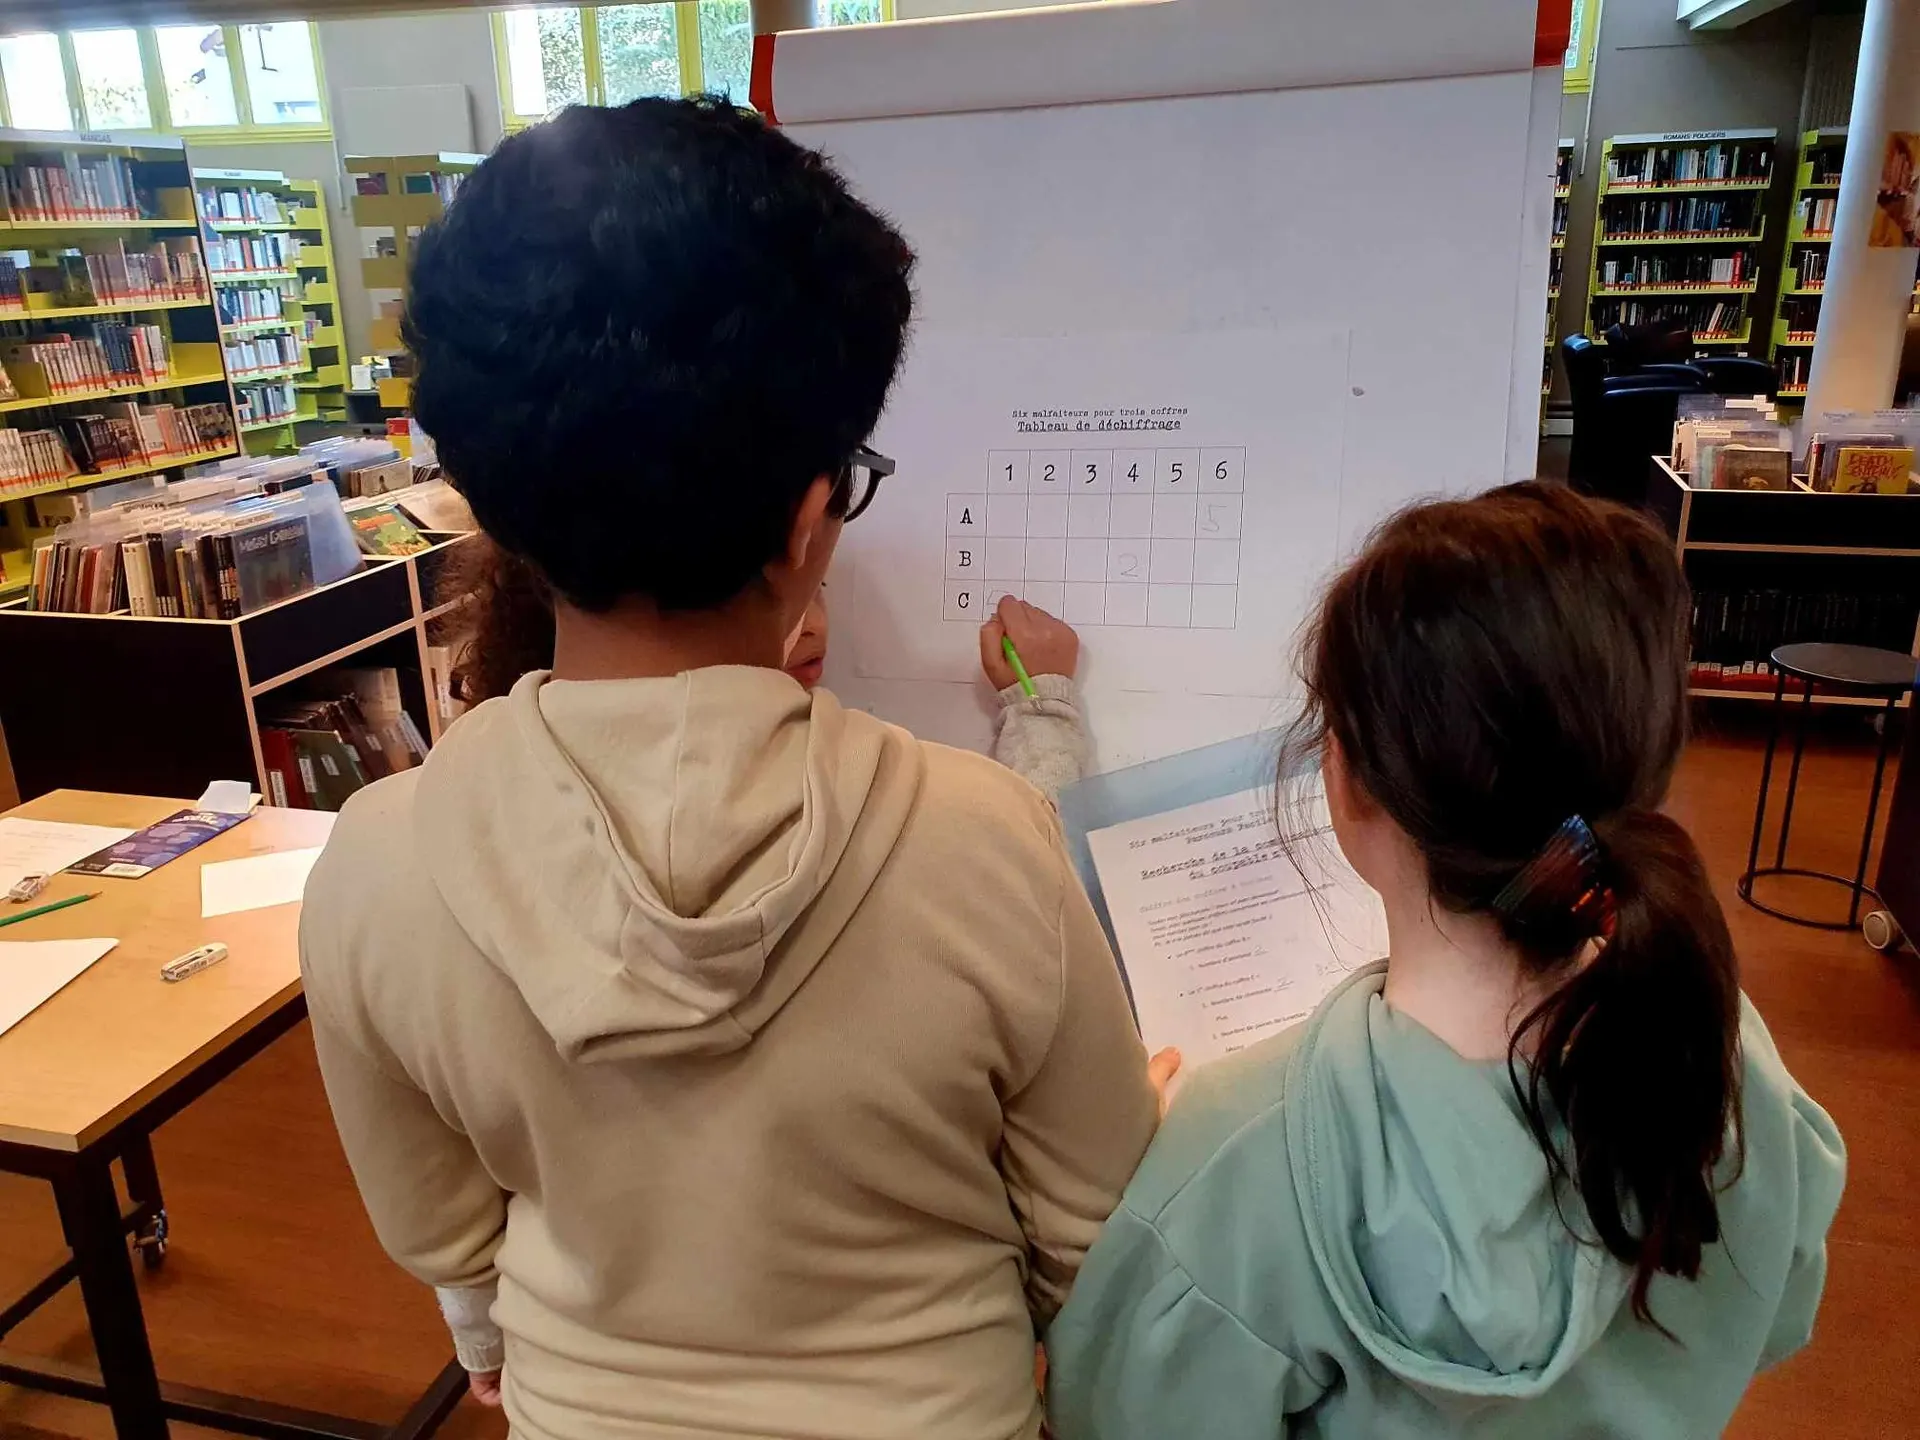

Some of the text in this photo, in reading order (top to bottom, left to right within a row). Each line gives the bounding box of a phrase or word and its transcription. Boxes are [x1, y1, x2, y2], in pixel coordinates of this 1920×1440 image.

[1012, 407, 1188, 419] Six malfaiteurs pour trois coffres
[1017, 418, 1182, 432] Tableau de déchiffrage
[1005, 461, 1228, 483] 1 2 3 4 5 6
[959, 508, 973, 524] A
[959, 551, 971, 567] B
[1118, 553, 1139, 577] 2
[958, 593, 970, 608] C
